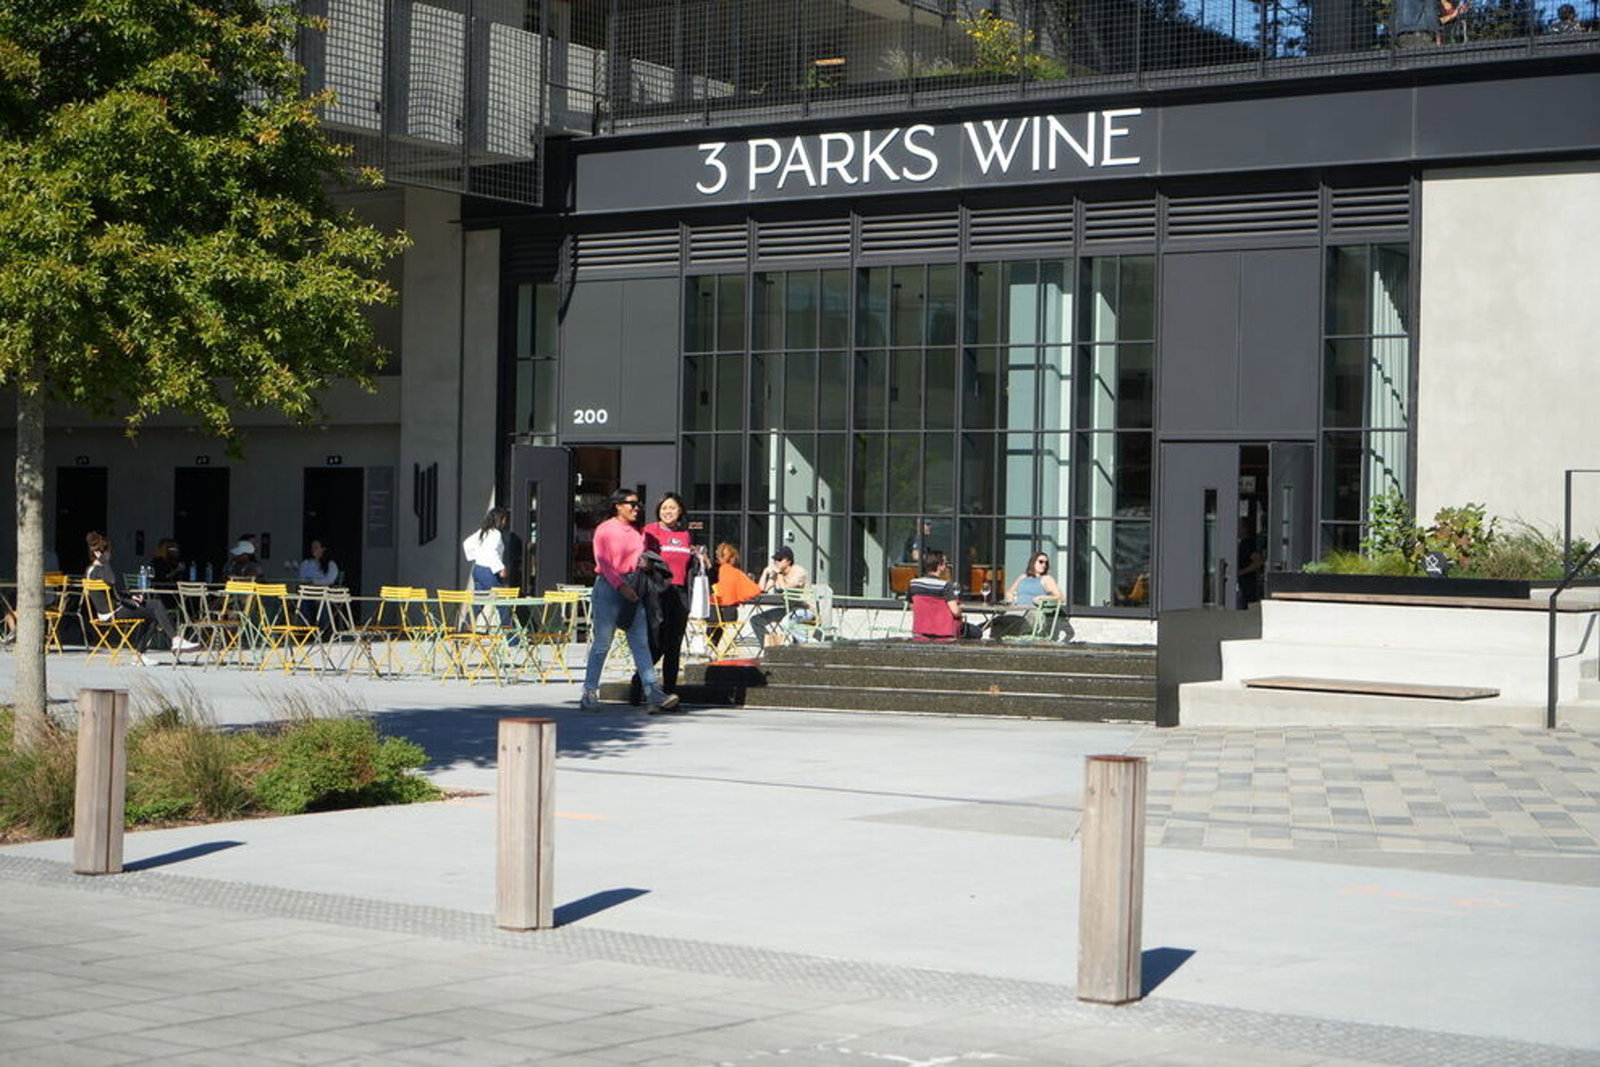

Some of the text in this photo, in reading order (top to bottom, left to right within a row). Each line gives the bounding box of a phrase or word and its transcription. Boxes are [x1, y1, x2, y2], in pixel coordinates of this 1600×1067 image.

[696, 107, 1142, 195] 3 PARKS WINE
[573, 409, 608, 425] 200
